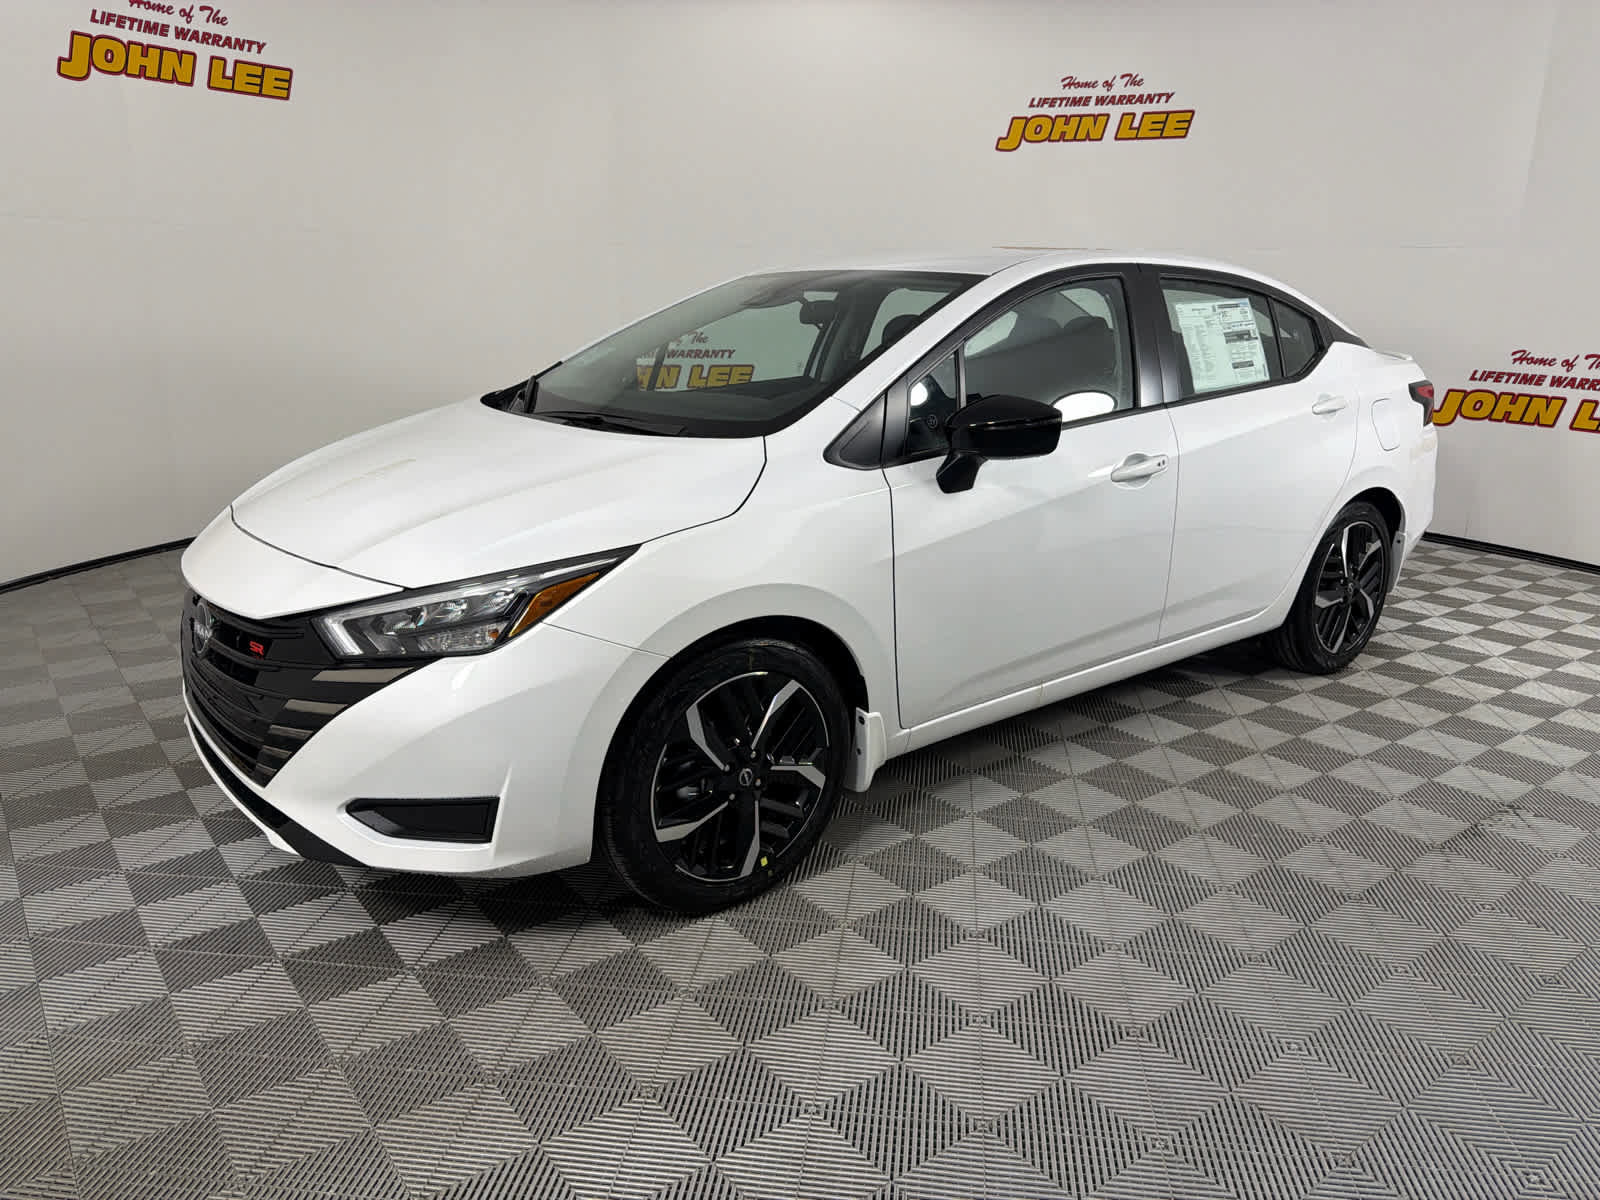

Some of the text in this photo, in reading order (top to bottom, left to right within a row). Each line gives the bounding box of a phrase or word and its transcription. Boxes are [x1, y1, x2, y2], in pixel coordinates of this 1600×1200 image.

[179, 4, 194, 24] of
[199, 5, 228, 26] The
[90, 9, 266, 54] LIFETIME WARRANTY
[57, 30, 293, 100] JOHN LEE
[1060, 73, 1144, 92] Home of The
[1028, 91, 1175, 108] LIFETIME WARRANTY
[995, 109, 1195, 152] JOHN LEE
[666, 349, 736, 359] WARRANTY
[1511, 349, 1557, 367] Home
[1561, 354, 1579, 373] of
[687, 364, 754, 388] LEE
[1469, 369, 1547, 387] LIFETIME
[1432, 388, 1600, 434] JOHN L
